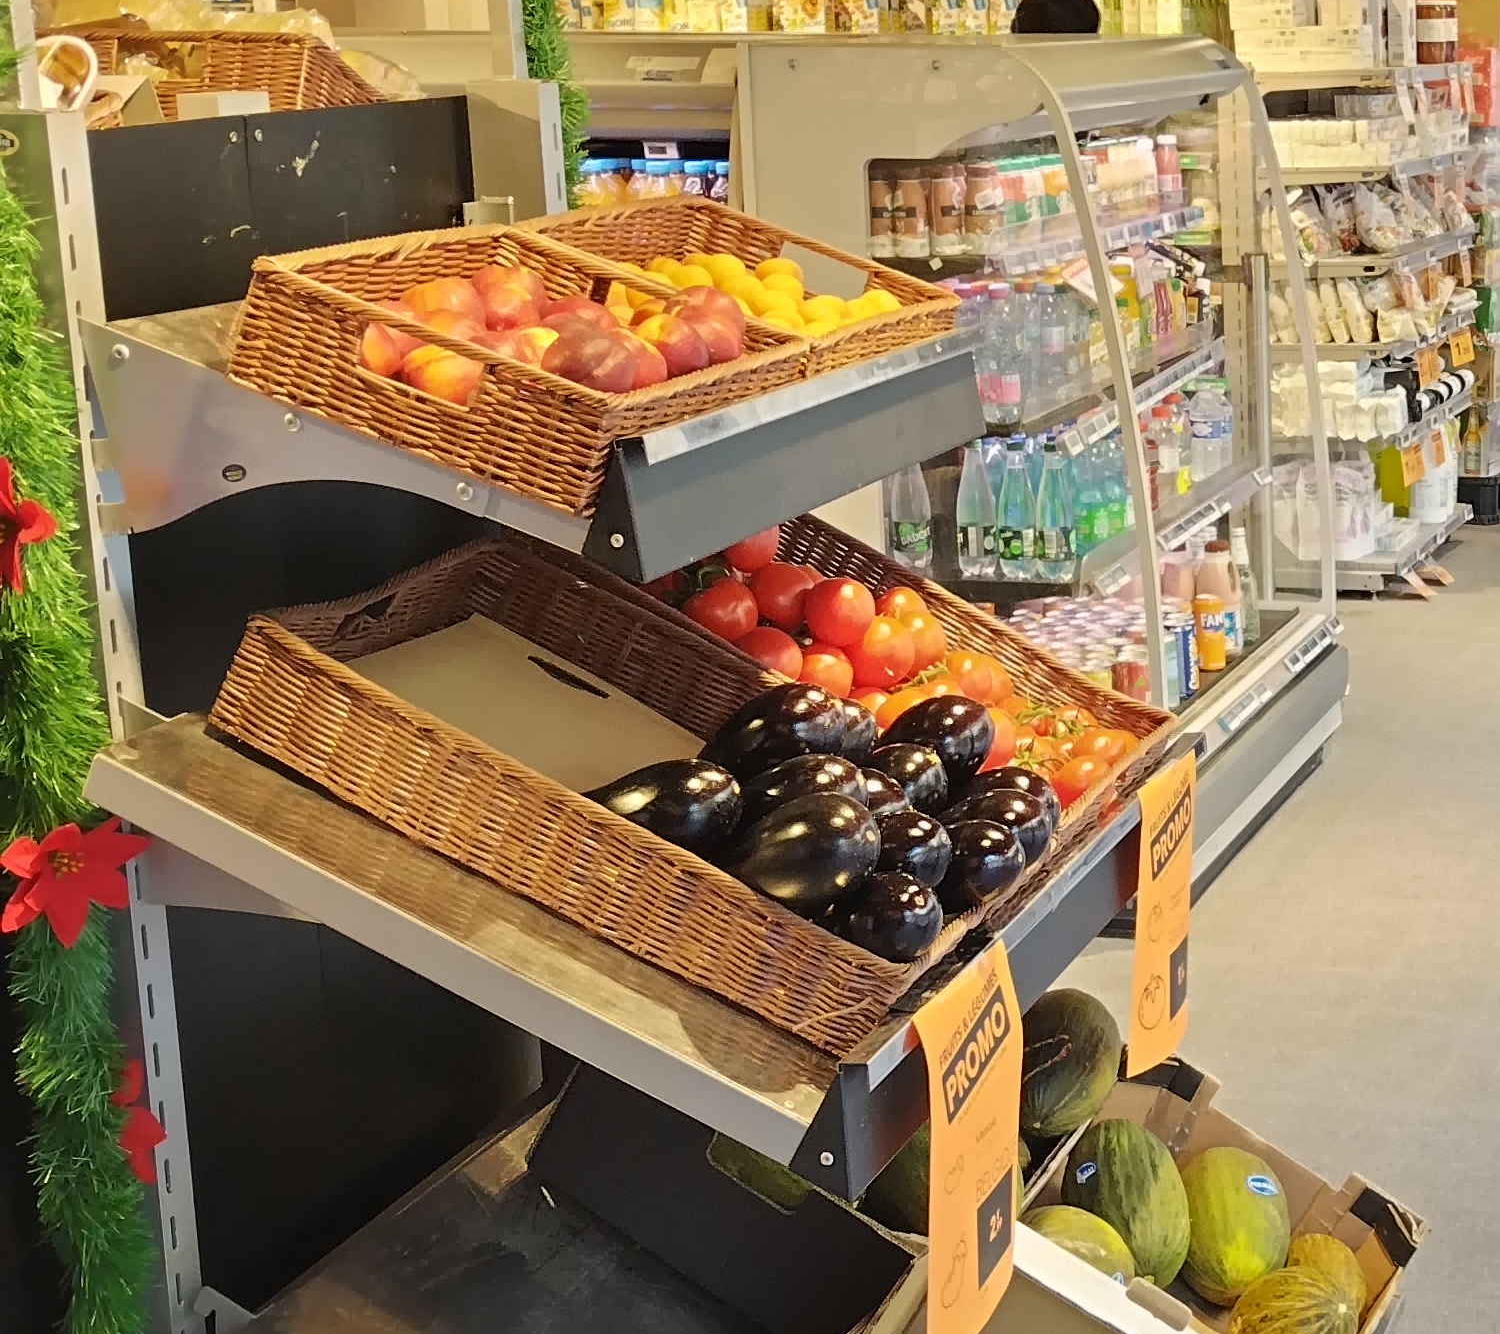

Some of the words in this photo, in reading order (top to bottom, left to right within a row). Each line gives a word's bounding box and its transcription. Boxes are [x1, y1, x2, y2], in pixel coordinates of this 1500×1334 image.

[1150, 808, 1167, 838] FRUITS
[1152, 796, 1191, 873] PROMO
[939, 1031, 963, 1071] FRUITS
[945, 1001, 1006, 1115] PROMO
